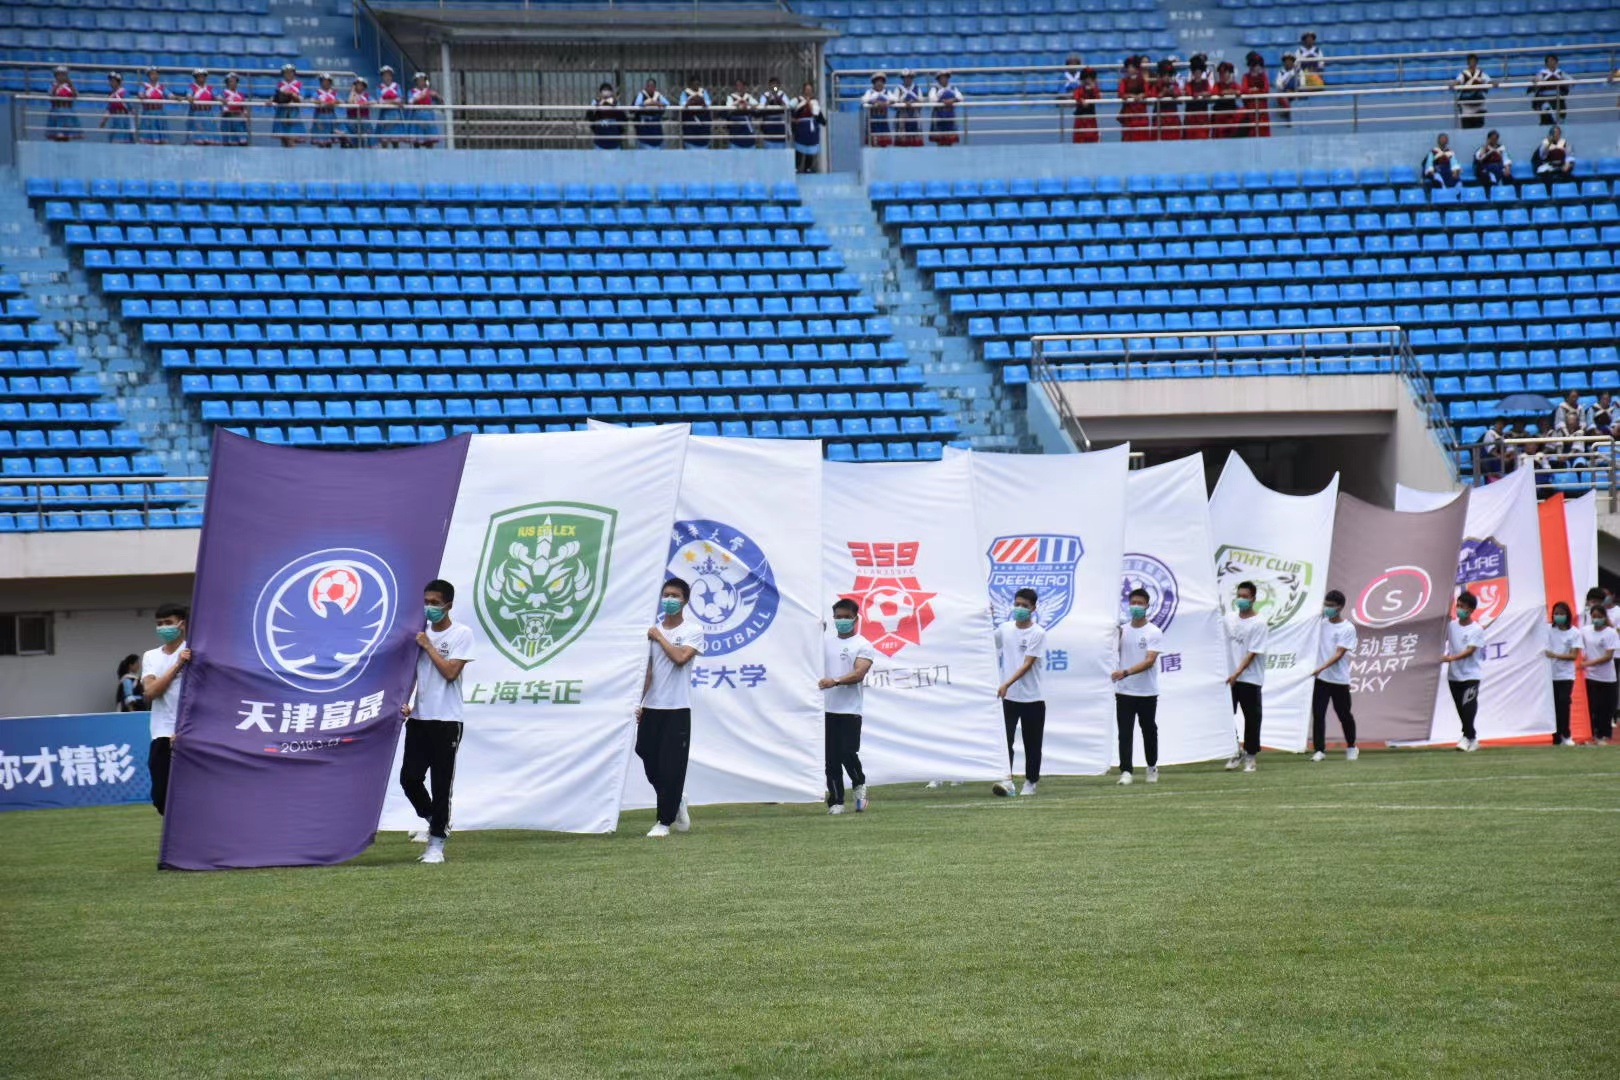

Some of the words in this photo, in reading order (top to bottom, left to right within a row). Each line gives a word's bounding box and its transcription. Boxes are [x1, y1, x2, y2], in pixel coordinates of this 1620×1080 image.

[554, 525, 576, 537] LEX
[847, 541, 920, 567] 359
[1457, 554, 1499, 573] TURE
[1266, 558, 1302, 573] CLUB
[994, 575, 1068, 586] DEEHERO
[1382, 590, 1402, 611] S
[703, 611, 771, 651] OOTBALL
[1351, 632, 1418, 657] 动星空
[691, 664, 767, 689] 华大学
[1349, 656, 1414, 675] MART
[463, 680, 583, 704] 上海华正
[1349, 676, 1391, 693] SKY
[235, 690, 384, 733] 天津富晟
[0, 744, 136, 791] 你才精彩
